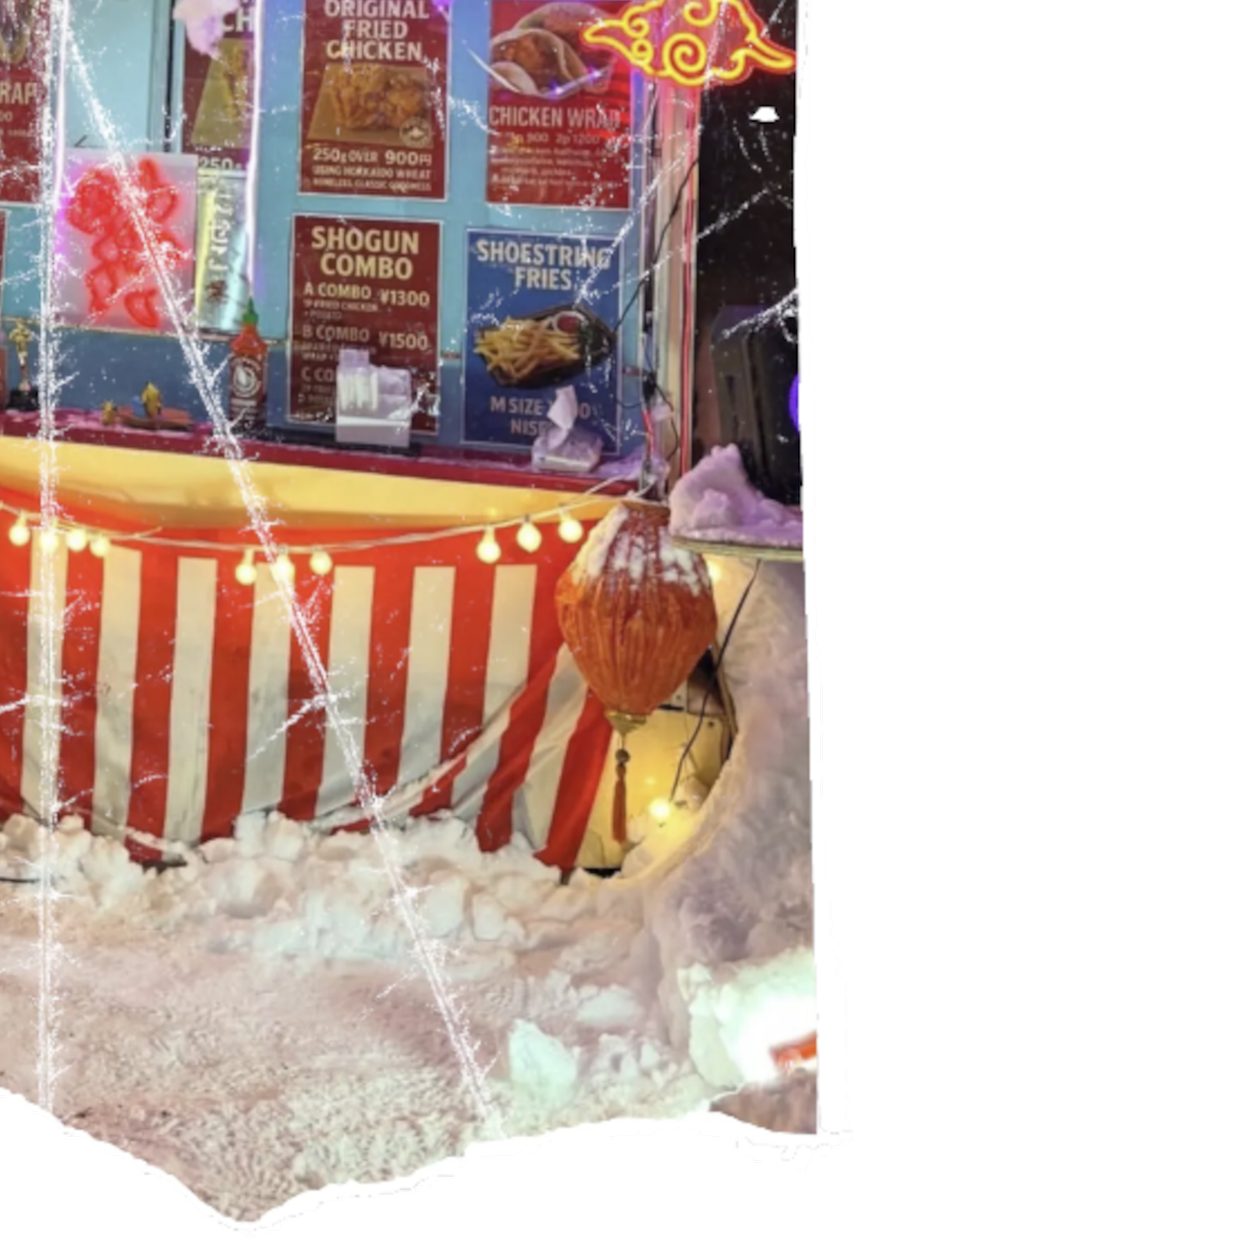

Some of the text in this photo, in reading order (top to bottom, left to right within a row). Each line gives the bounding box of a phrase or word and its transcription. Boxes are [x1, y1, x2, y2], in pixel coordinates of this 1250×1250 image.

[343, 19, 409, 39] FRIED
[327, 40, 422, 62] CHICKEN
[489, 106, 621, 130] CHICKEN WRAP
[311, 225, 419, 254] SHOGUN
[320, 253, 414, 280] COMBO
[477, 239, 612, 270] SHOESTRING
[515, 266, 573, 291] FRIES
[304, 282, 430, 308] A COMBO ¥1300
[302, 324, 313, 338] B
[316, 325, 371, 342] COMBO
[379, 331, 429, 350] ¥1500
[490, 396, 507, 413] M
[509, 398, 544, 415] SIZE
